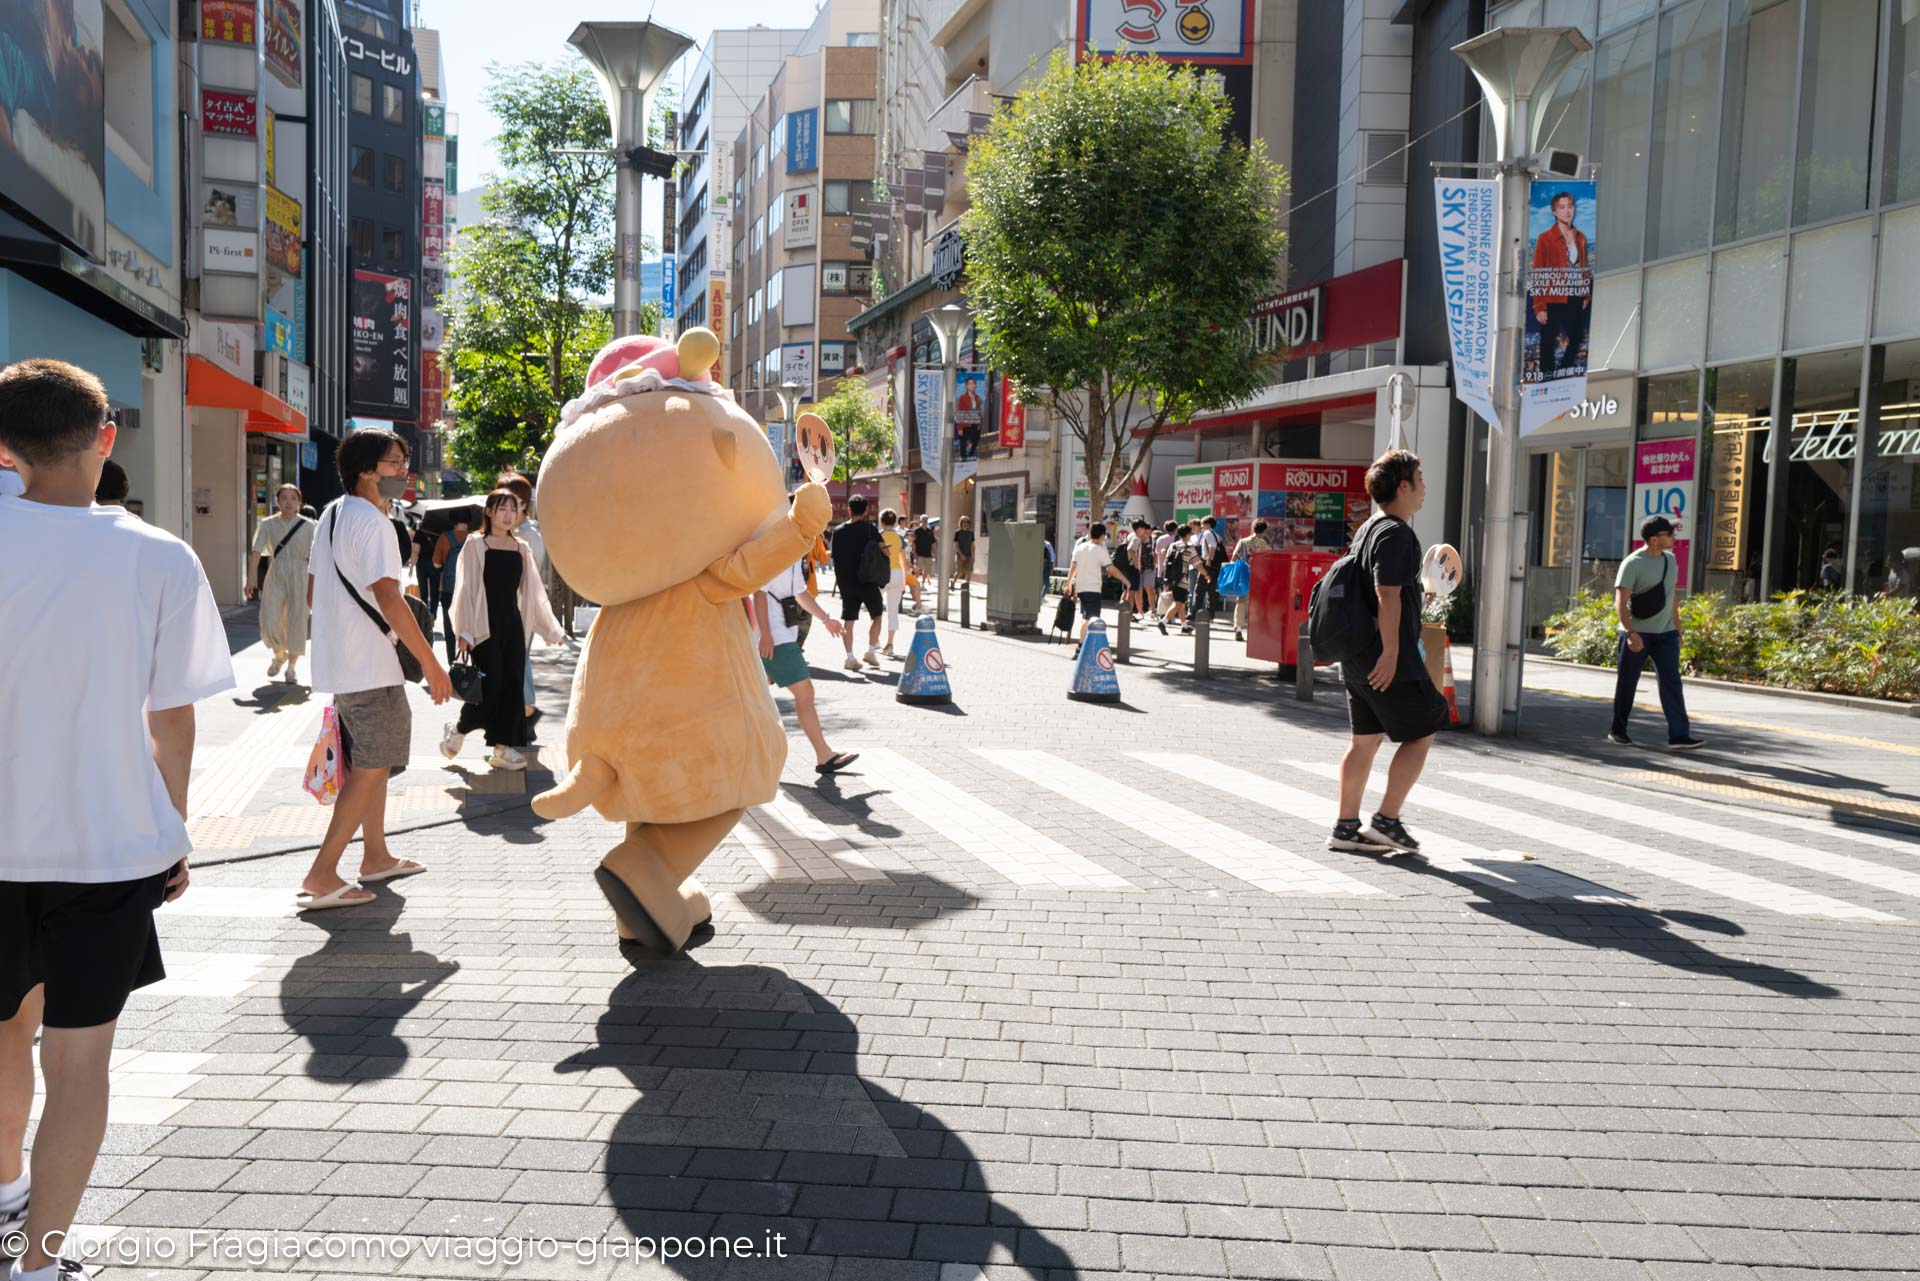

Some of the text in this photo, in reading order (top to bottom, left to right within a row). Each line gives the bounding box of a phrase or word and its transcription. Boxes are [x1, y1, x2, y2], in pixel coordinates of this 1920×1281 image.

[206, 99, 245, 113] タイ古式
[205, 112, 256, 124] マッサージ
[791, 218, 809, 227] OPEN
[1442, 187, 1466, 358] SKY MUSEUM
[1464, 187, 1478, 364] TENBOU-PARK EXILE TAKAHIRO
[1475, 187, 1492, 364] SUNSHINE 60 OBSERVATORY
[1530, 272, 1583, 280] TENBOU-PARK
[1529, 286, 1590, 296] SKY MUSEUM
[394, 279, 408, 406] 焼肉食べ放題
[1526, 371, 1544, 382] 9.18
[917, 374, 929, 454] SKY MUSEUM
[1219, 468, 1249, 487] ROUND1
[1650, 463, 1680, 475] おまかせ
[1285, 469, 1348, 488] ROUND1
[1177, 487, 1212, 505] サイゼリヤ
[1644, 487, 1687, 518] UQ
